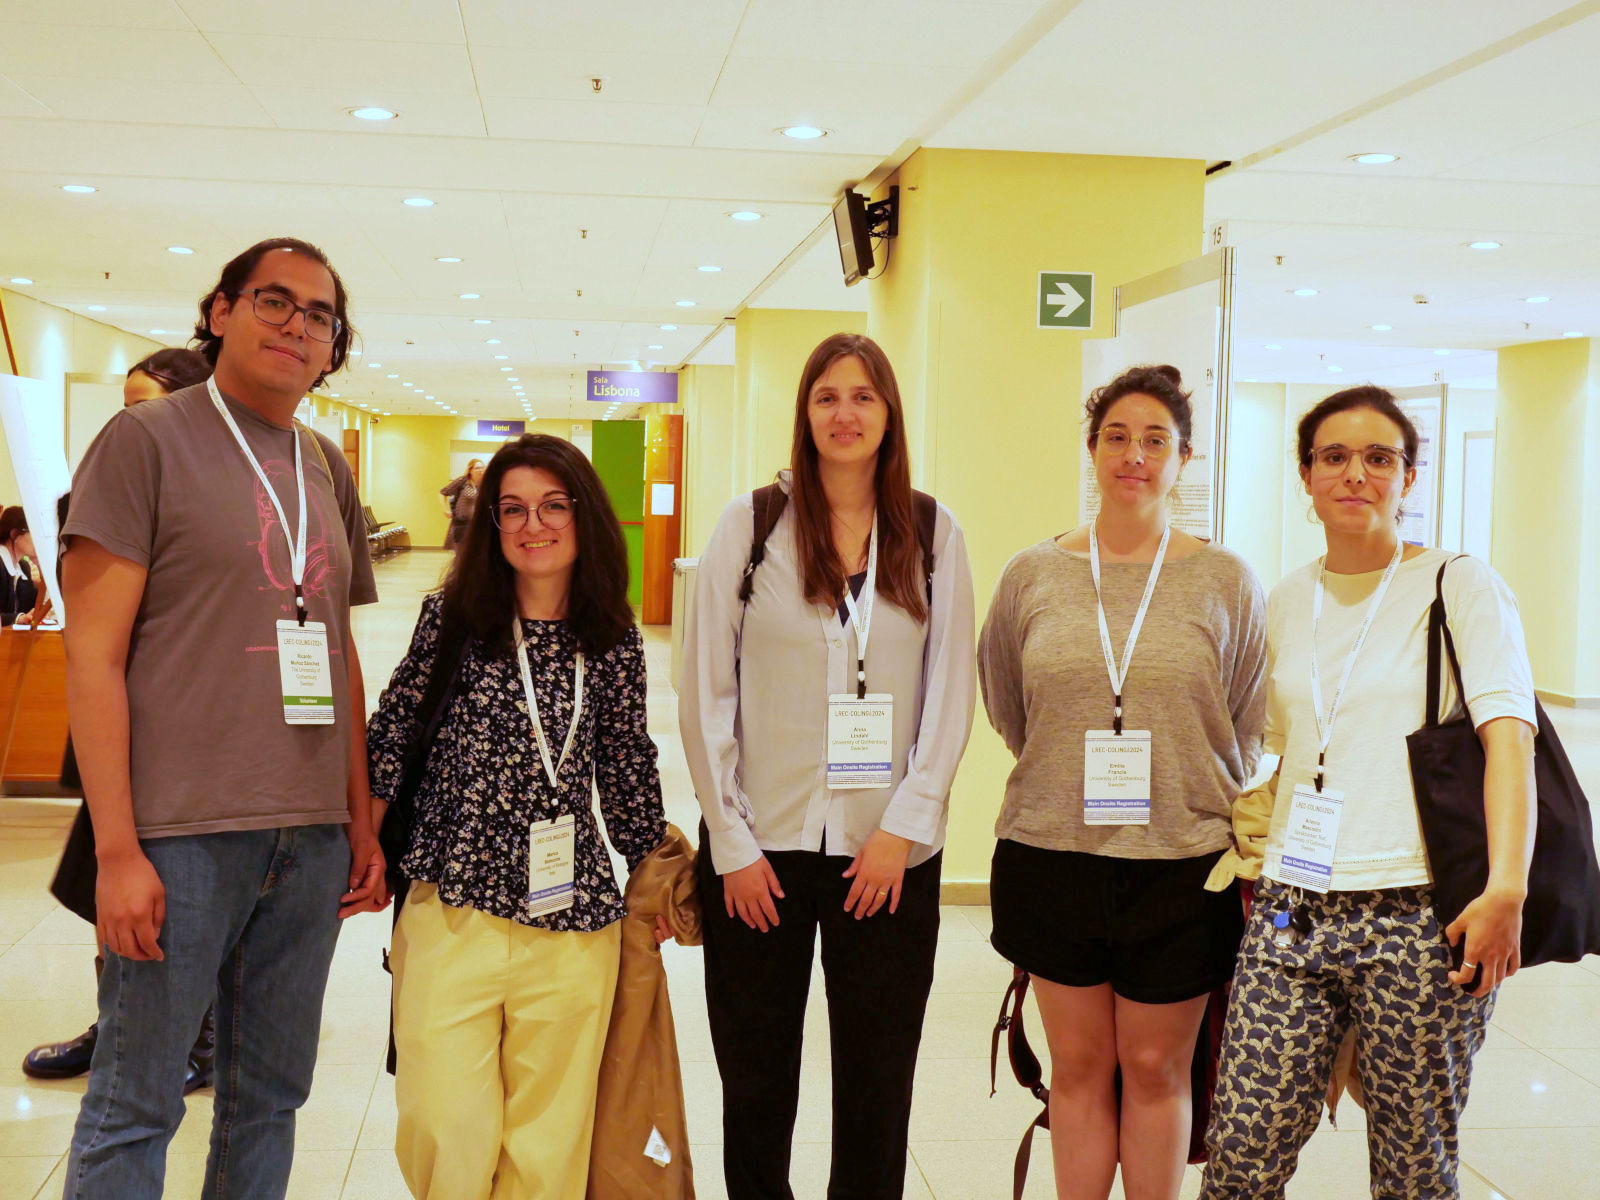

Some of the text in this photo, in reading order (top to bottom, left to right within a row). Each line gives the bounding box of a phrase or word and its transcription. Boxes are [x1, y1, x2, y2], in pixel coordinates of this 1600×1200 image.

[1213, 226, 1222, 246] 15
[594, 384, 640, 397] Lisbona
[492, 424, 510, 432] Hotel
